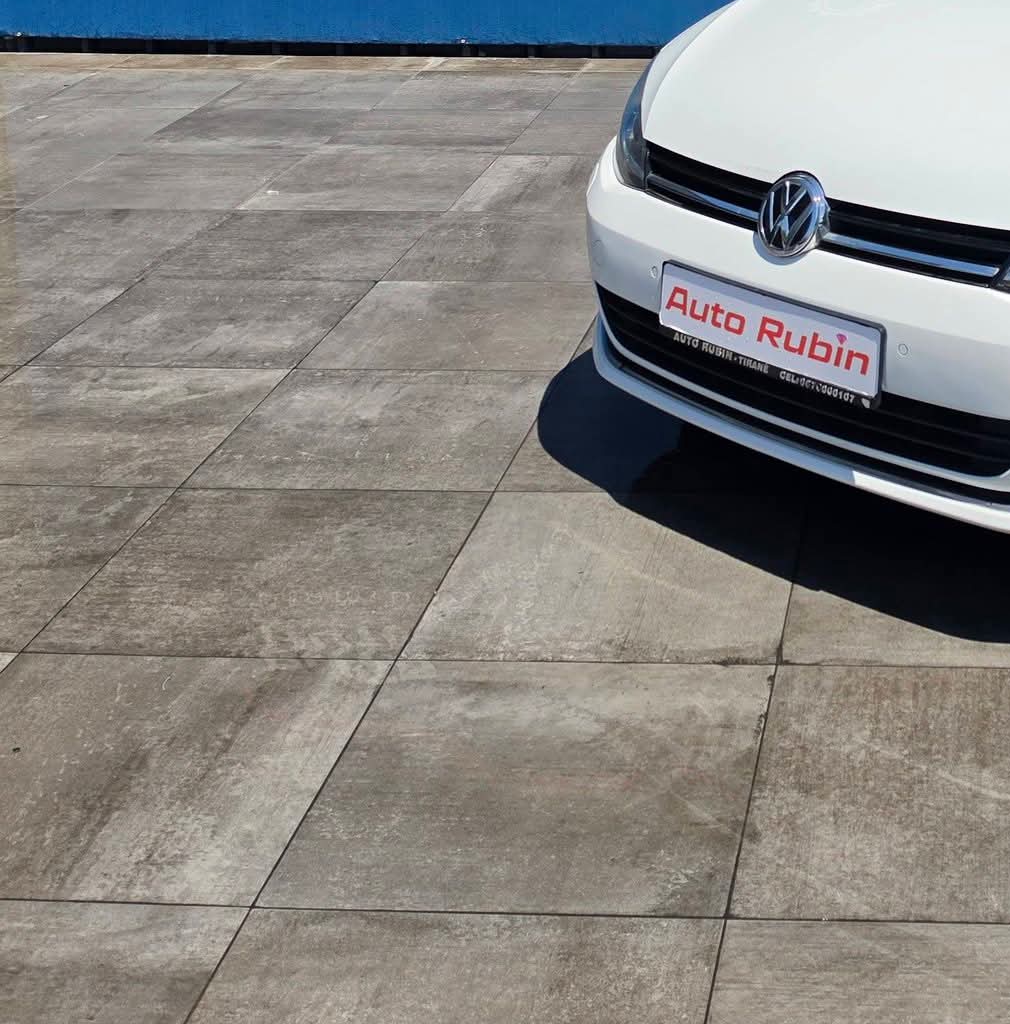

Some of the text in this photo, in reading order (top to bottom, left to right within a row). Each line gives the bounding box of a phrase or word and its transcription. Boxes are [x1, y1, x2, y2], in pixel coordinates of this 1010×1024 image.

[666, 286, 870, 375] Auto Rubin
[673, 332, 699, 349] AUTO
